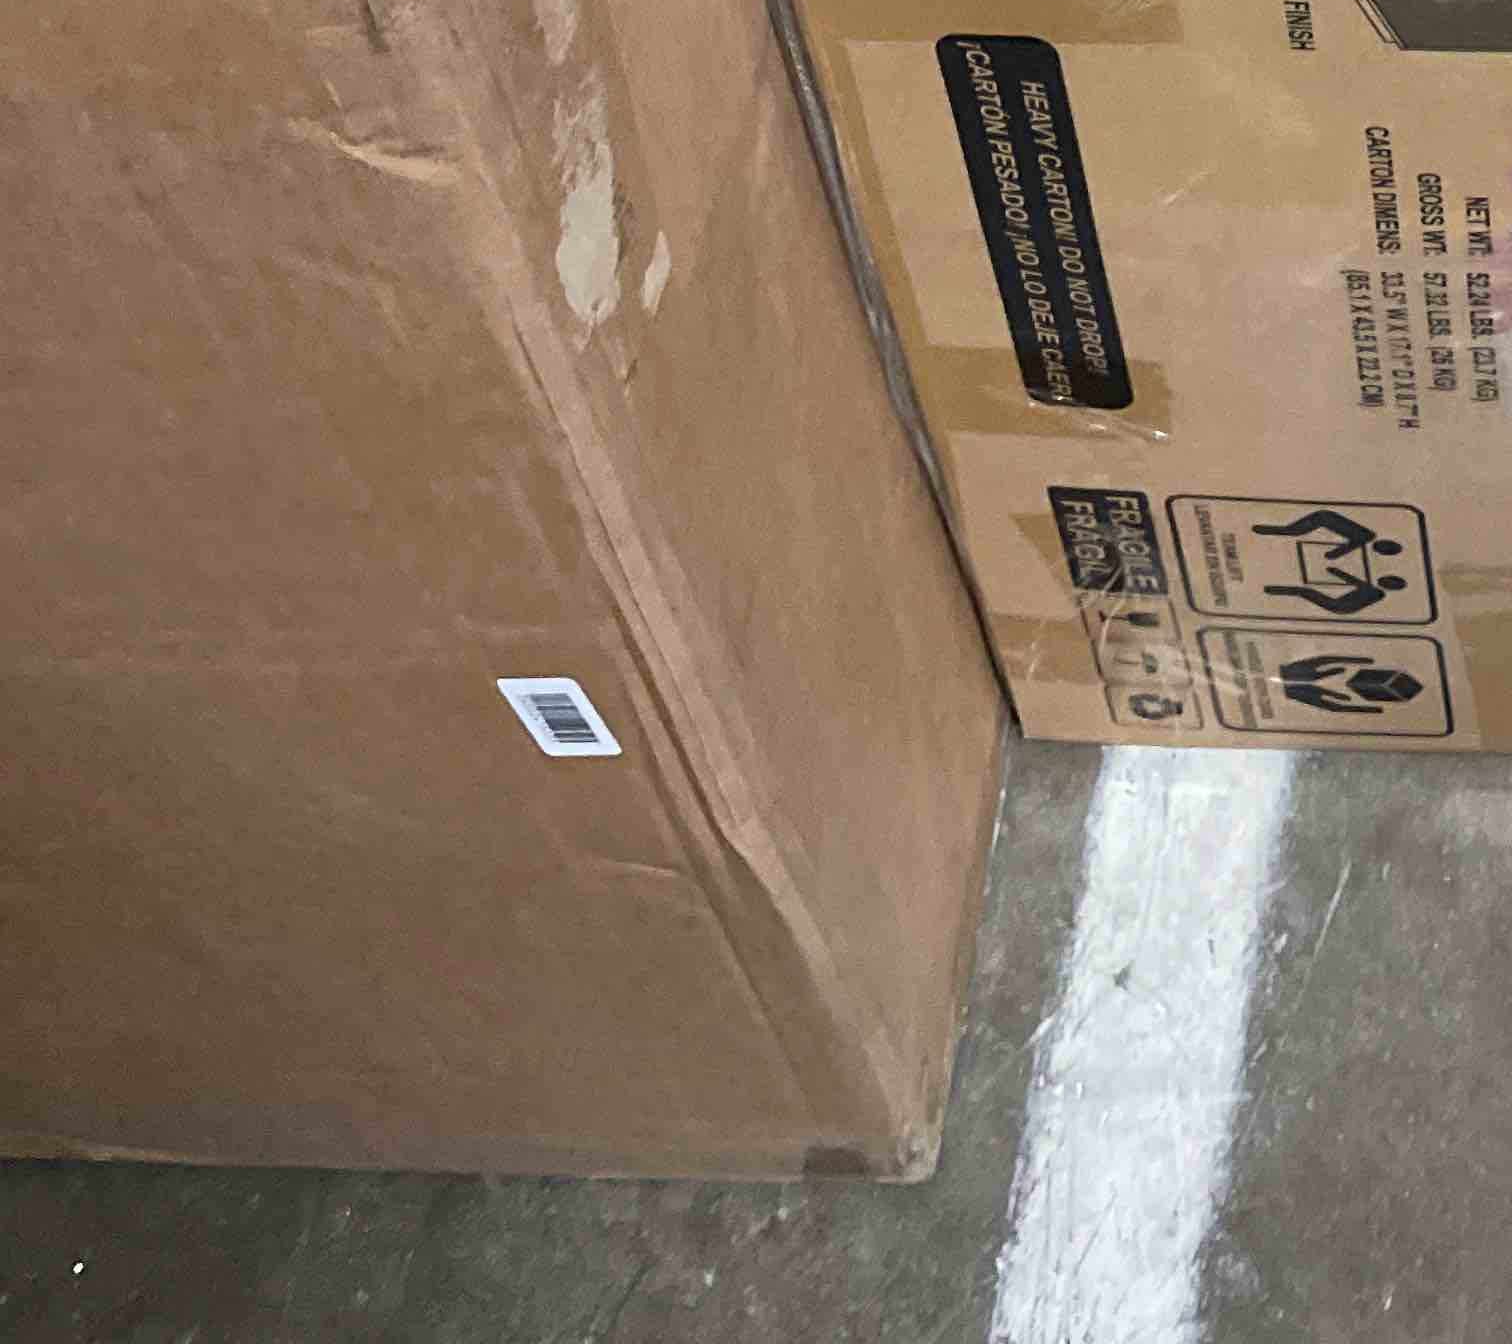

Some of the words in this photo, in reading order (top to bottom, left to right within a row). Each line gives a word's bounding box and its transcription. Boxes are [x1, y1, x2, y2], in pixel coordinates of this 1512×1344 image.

[1285, 0, 1317, 52] FINISH
[1020, 79, 1059, 150] HEAVY
[1365, 126, 1395, 190] CARTON
[1374, 191, 1401, 256] DIMENS:
[1417, 172, 1444, 227] GROSS
[1465, 196, 1491, 231] NET
[1060, 246, 1085, 277] DO
[1423, 229, 1449, 257] WT:
[1467, 231, 1493, 258] WT:
[1020, 270, 1047, 296] LO
[1067, 277, 1095, 318] NOT
[1027, 295, 1061, 350] DEJE
[1104, 494, 1159, 594] FRAGILE
